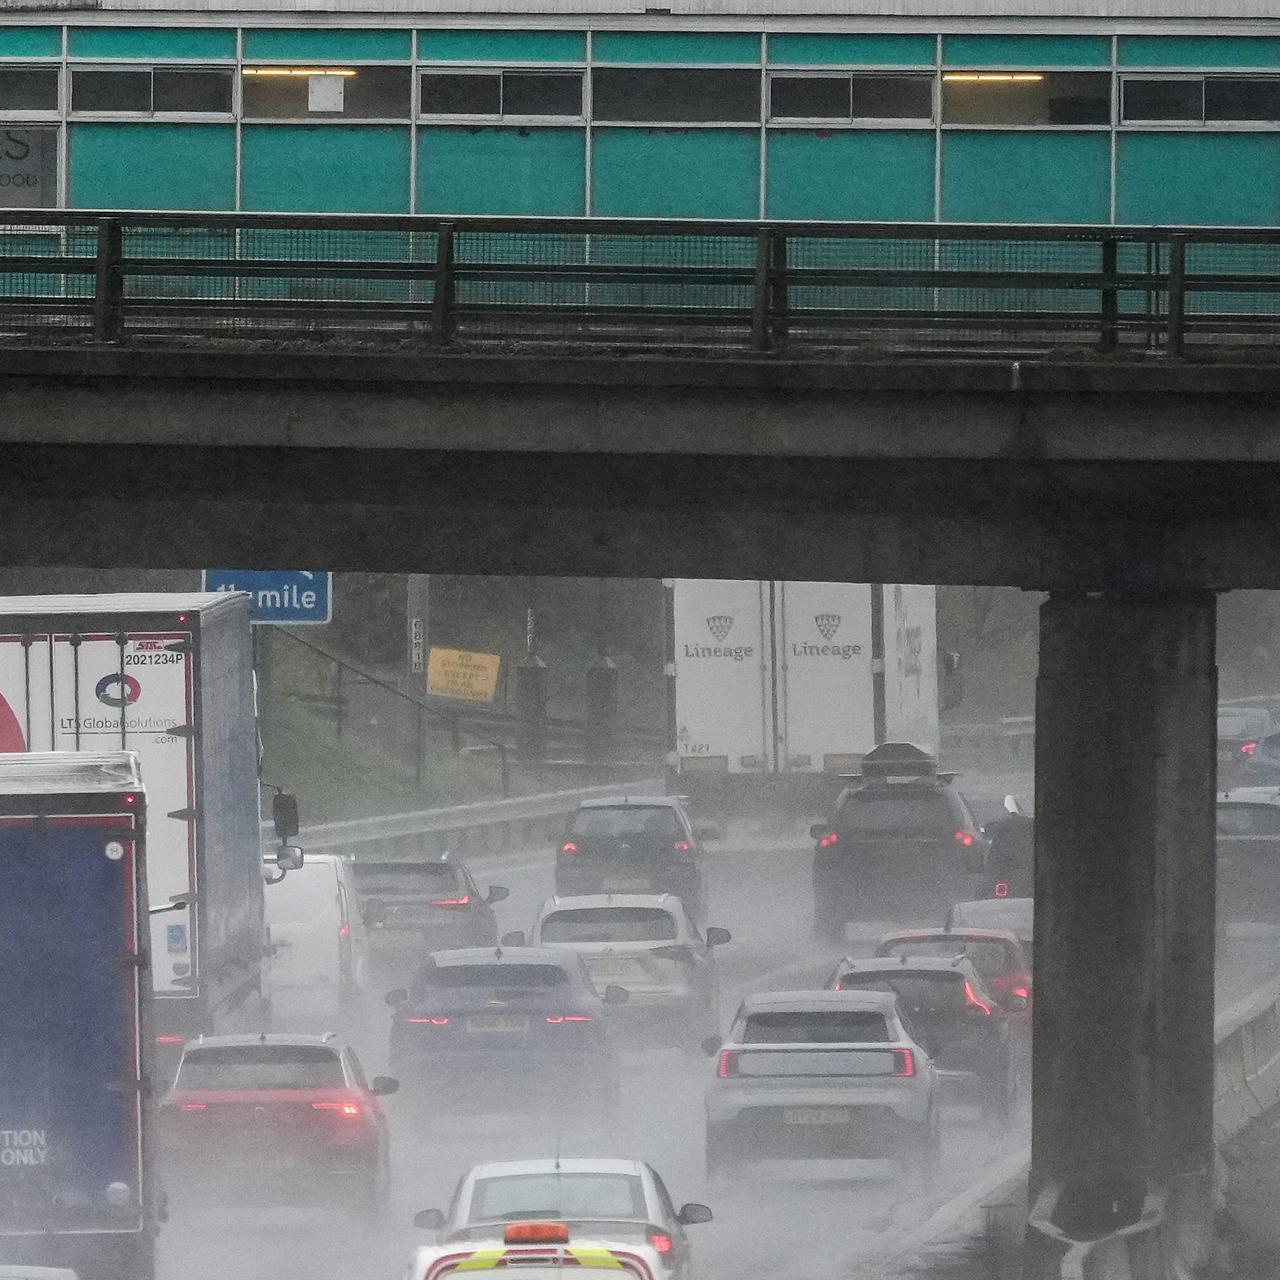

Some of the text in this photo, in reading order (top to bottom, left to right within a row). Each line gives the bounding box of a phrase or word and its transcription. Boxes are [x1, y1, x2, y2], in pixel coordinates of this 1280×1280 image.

[257, 584, 317, 609] mile
[124, 653, 184, 666] 2021234P
[683, 643, 754, 662] Lineage
[792, 642, 862, 661] Lineage
[0, 1149, 48, 1167] ONLY
